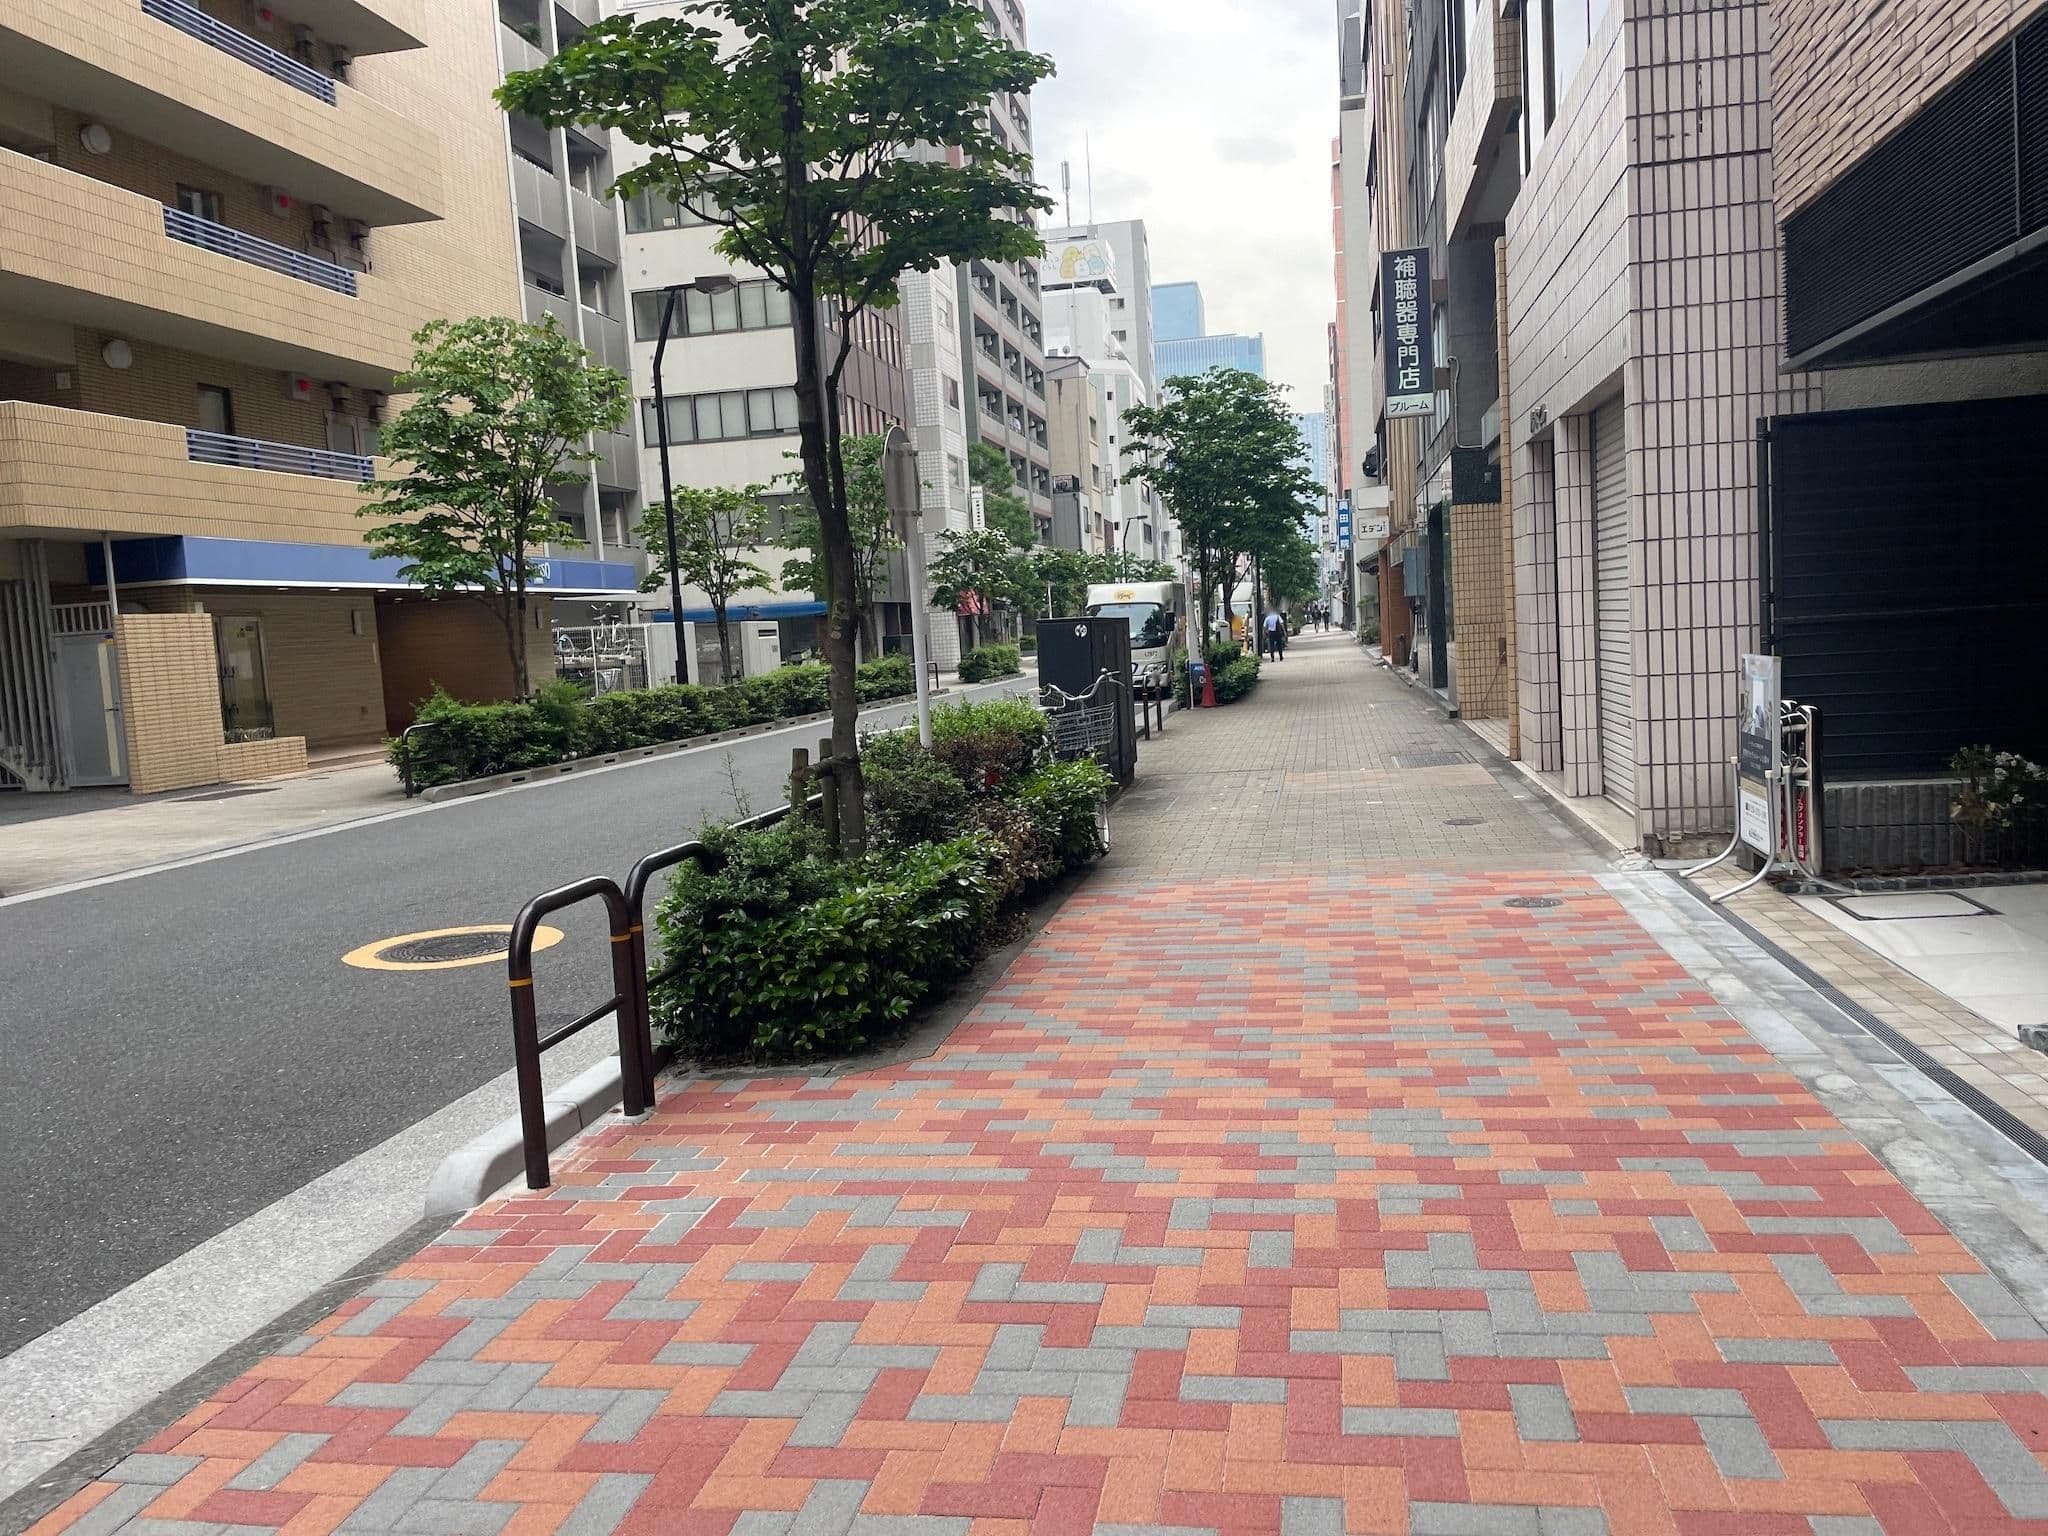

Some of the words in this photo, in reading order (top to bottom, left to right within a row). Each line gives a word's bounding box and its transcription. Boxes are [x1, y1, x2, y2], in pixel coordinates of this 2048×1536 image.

[1393, 255, 1420, 391] 補聴器専門店
[1361, 524, 1383, 534] エデン
